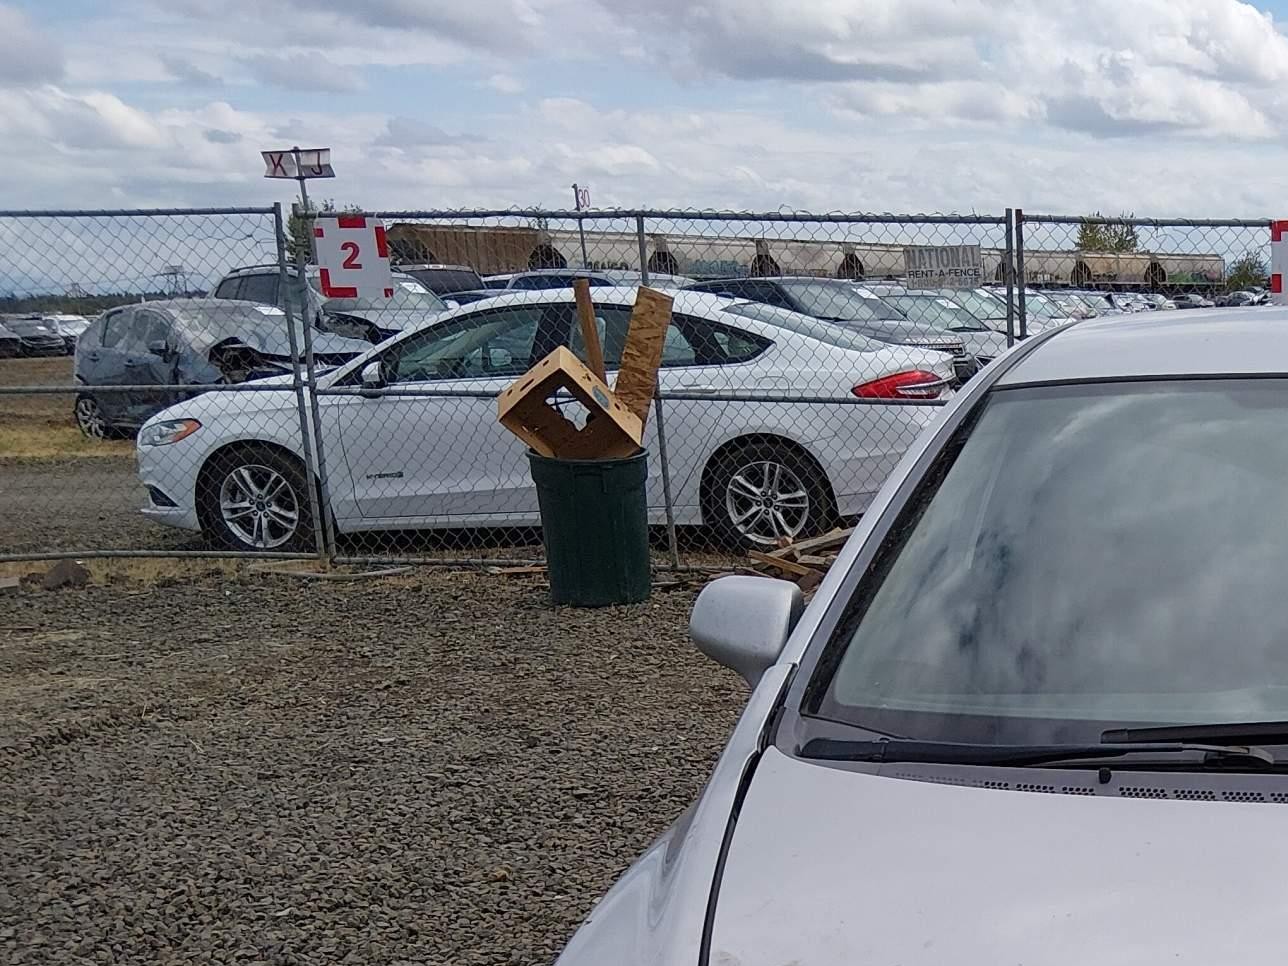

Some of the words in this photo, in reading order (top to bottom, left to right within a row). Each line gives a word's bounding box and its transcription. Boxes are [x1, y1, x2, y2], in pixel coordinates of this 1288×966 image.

[310, 151, 323, 176] J
[340, 241, 363, 270] 2
[906, 247, 980, 269] NATIONAL
[908, 267, 981, 279] RENT-A-FENCE
